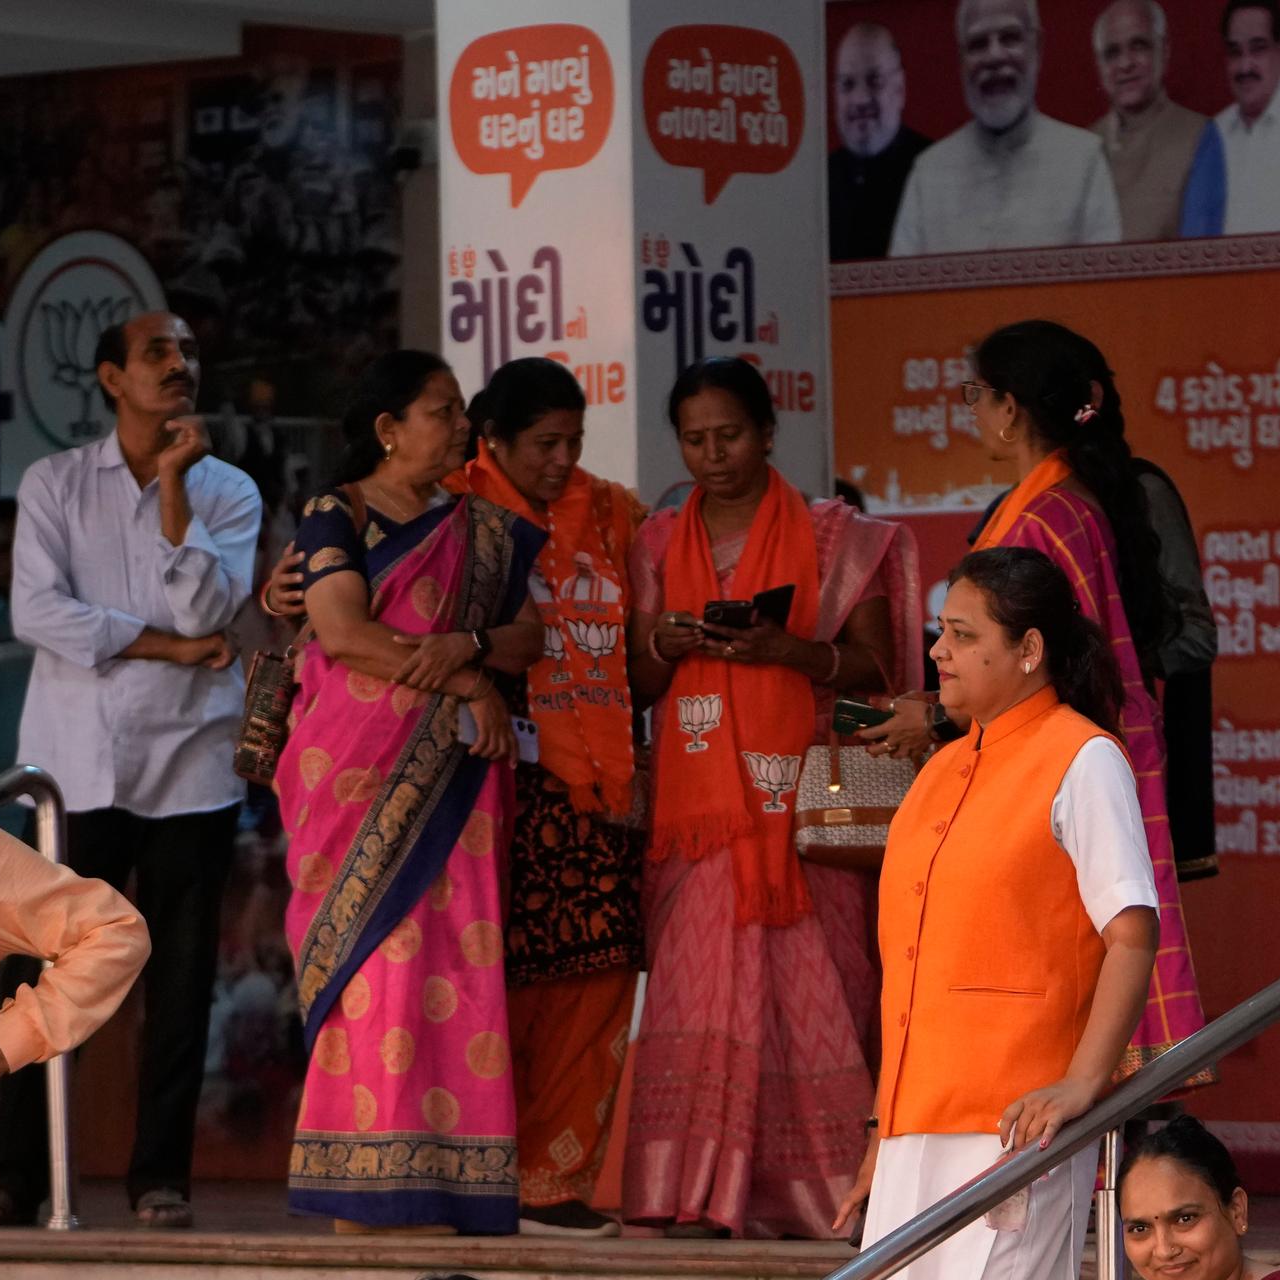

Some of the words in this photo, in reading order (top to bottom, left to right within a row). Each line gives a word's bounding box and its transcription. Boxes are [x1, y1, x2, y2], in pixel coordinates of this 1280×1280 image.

[472, 50, 519, 99] મને
[668, 48, 713, 95] મને
[546, 105, 585, 142] ઘર
[1154, 375, 1177, 413] 4
